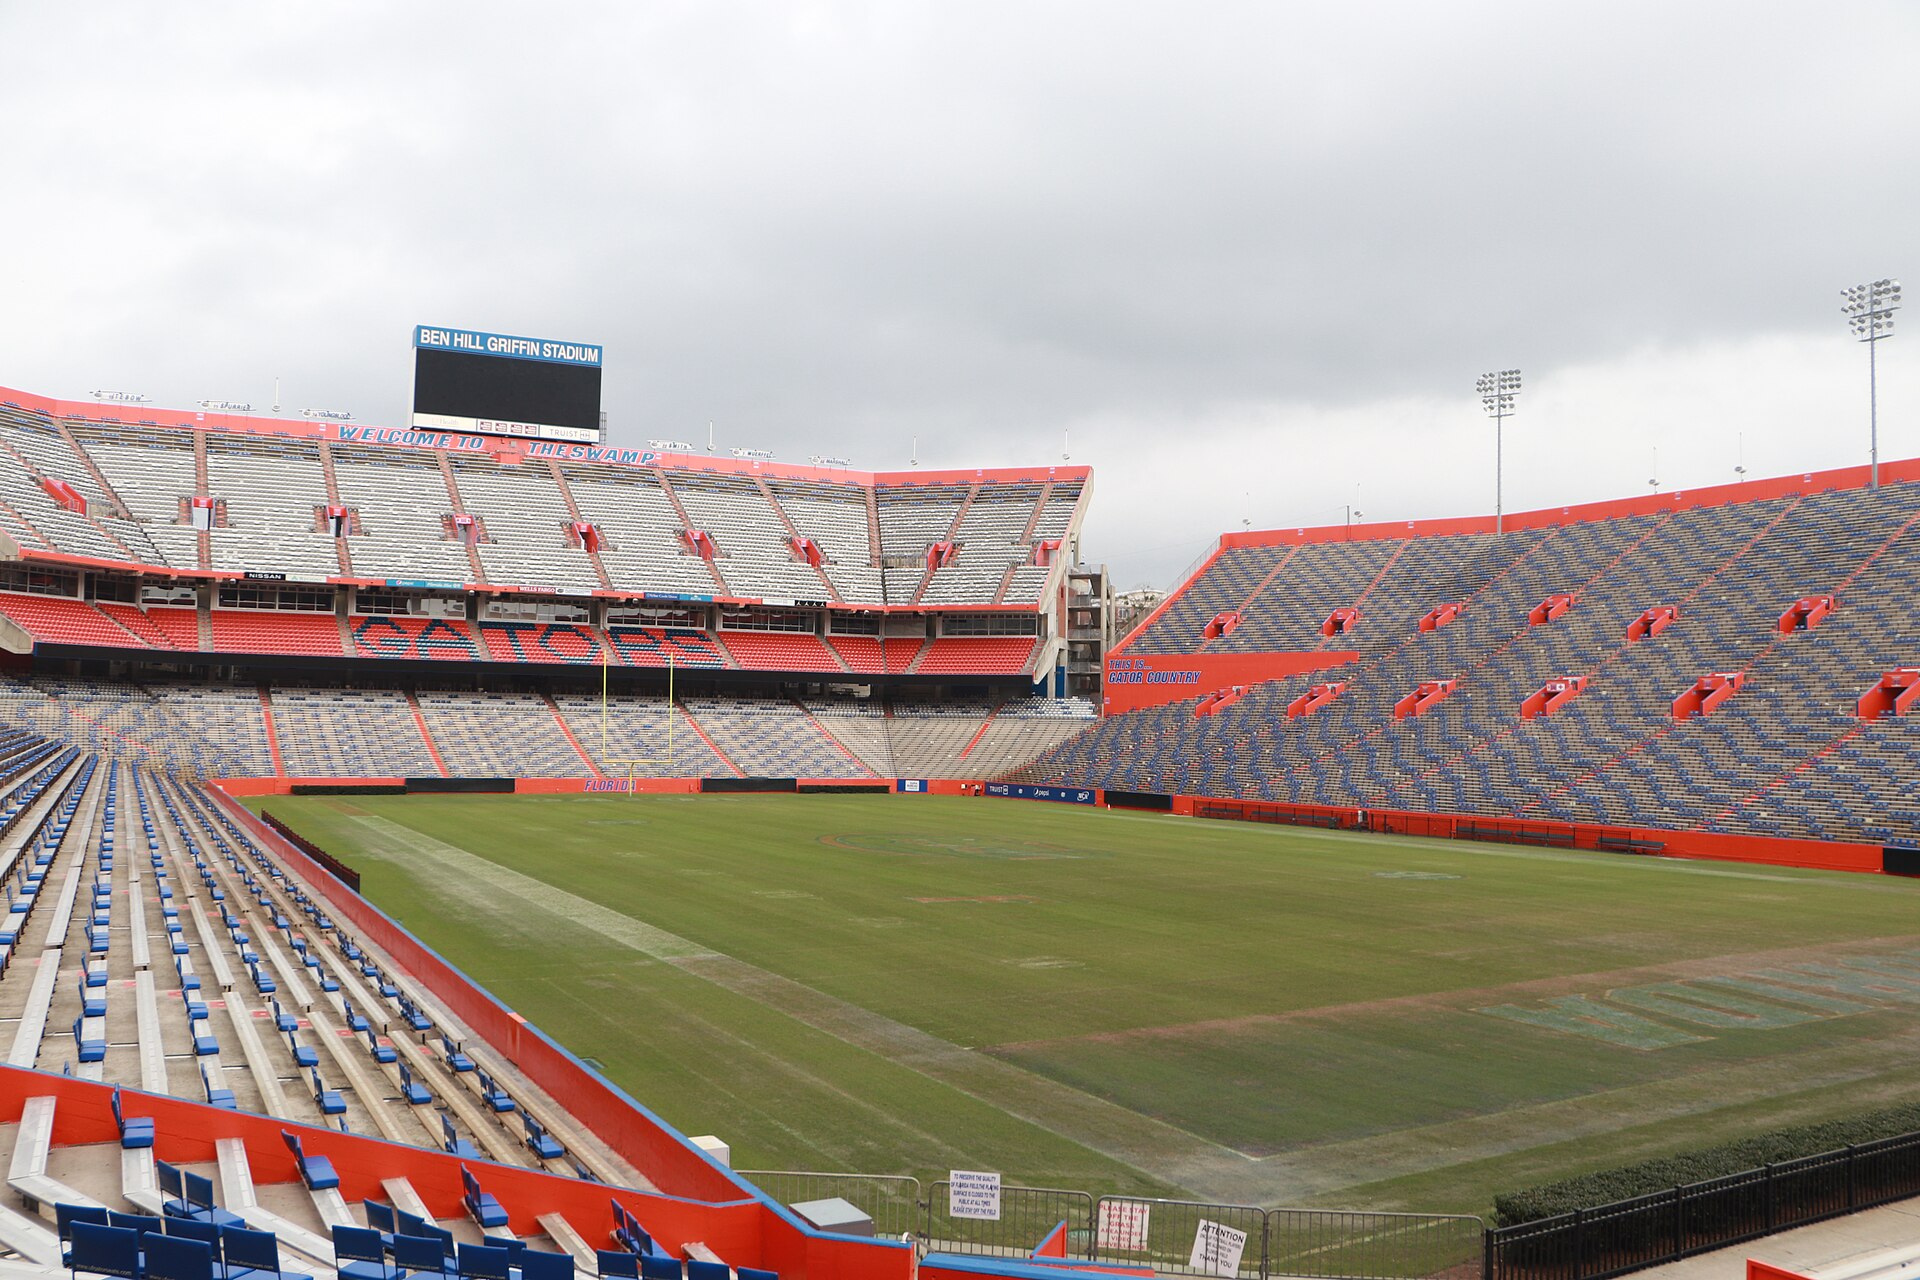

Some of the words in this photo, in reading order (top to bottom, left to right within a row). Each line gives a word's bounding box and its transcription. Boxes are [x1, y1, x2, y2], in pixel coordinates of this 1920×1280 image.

[420, 329, 450, 346] BEN
[453, 333, 484, 350] HILL
[487, 337, 540, 356] GRIFFIN
[542, 343, 599, 362] STADIUM
[550, 429, 578, 437] TRUIST
[338, 426, 452, 448] WELCOME
[458, 436, 485, 449] TO
[528, 441, 570, 457] THE
[570, 446, 657, 465] SWAMP
[353, 616, 729, 668] GATORS
[1108, 659, 1131, 670] THIS
[1108, 671, 1143, 684] GATOR
[1146, 671, 1201, 684] COUNTRY
[584, 780, 637, 792] FLORIDA
[989, 785, 1003, 793] TRUIST
[1038, 789, 1050, 797] pepsi
[1098, 1204, 1128, 1212] PLEASE
[1110, 1221, 1135, 1229] GRASS
[1201, 1224, 1245, 1243] ATTENTION
[1220, 1259, 1233, 1268] YOU
